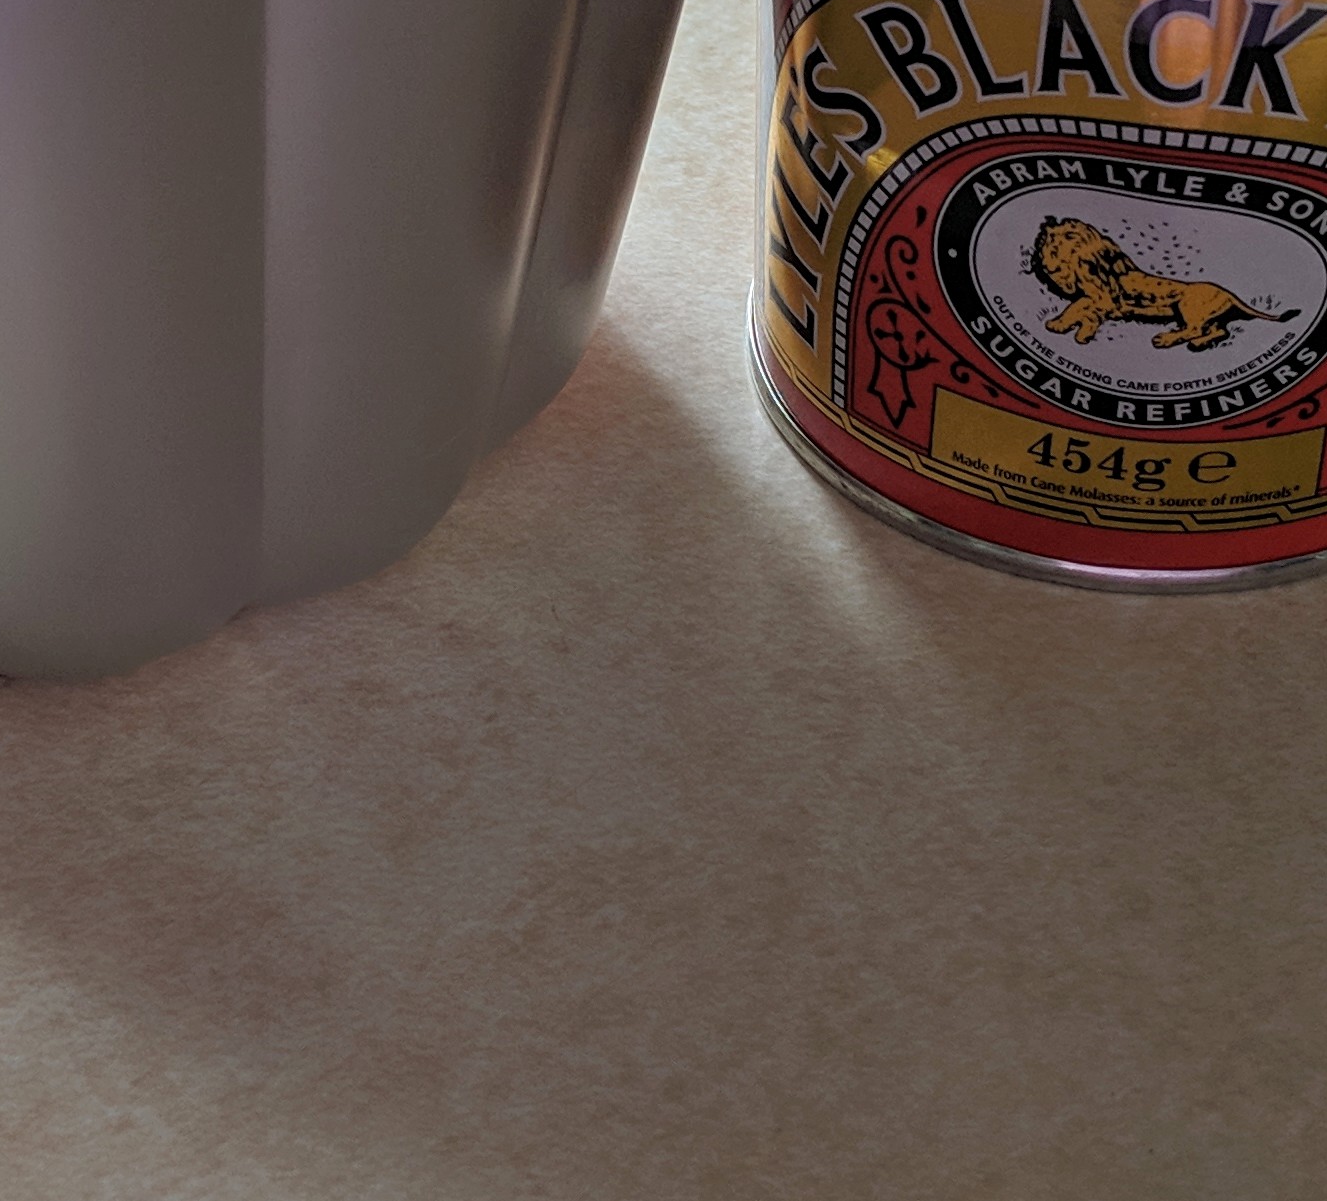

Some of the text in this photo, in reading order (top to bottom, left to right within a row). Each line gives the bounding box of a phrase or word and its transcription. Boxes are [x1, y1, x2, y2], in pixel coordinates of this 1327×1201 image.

[766, 37, 887, 354] LYLE'S
[972, 158, 1086, 206] ABRAM
[1105, 164, 1206, 198] LYLE
[1224, 182, 1248, 204] &
[970, 315, 1319, 422] SUGAR REFINERS
[993, 295, 1297, 393] OUT OF THE STRONG CAME FORTH SWEETNESS
[952, 450, 990, 474] Made
[993, 463, 1027, 486] from
[1030, 475, 1066, 495] Cane
[1069, 484, 1141, 506] Molasses:
[1144, 495, 1155, 506] a
[1158, 496, 1207, 508] source
[1210, 493, 1227, 507] of
[1026, 432, 1172, 492] 454g
